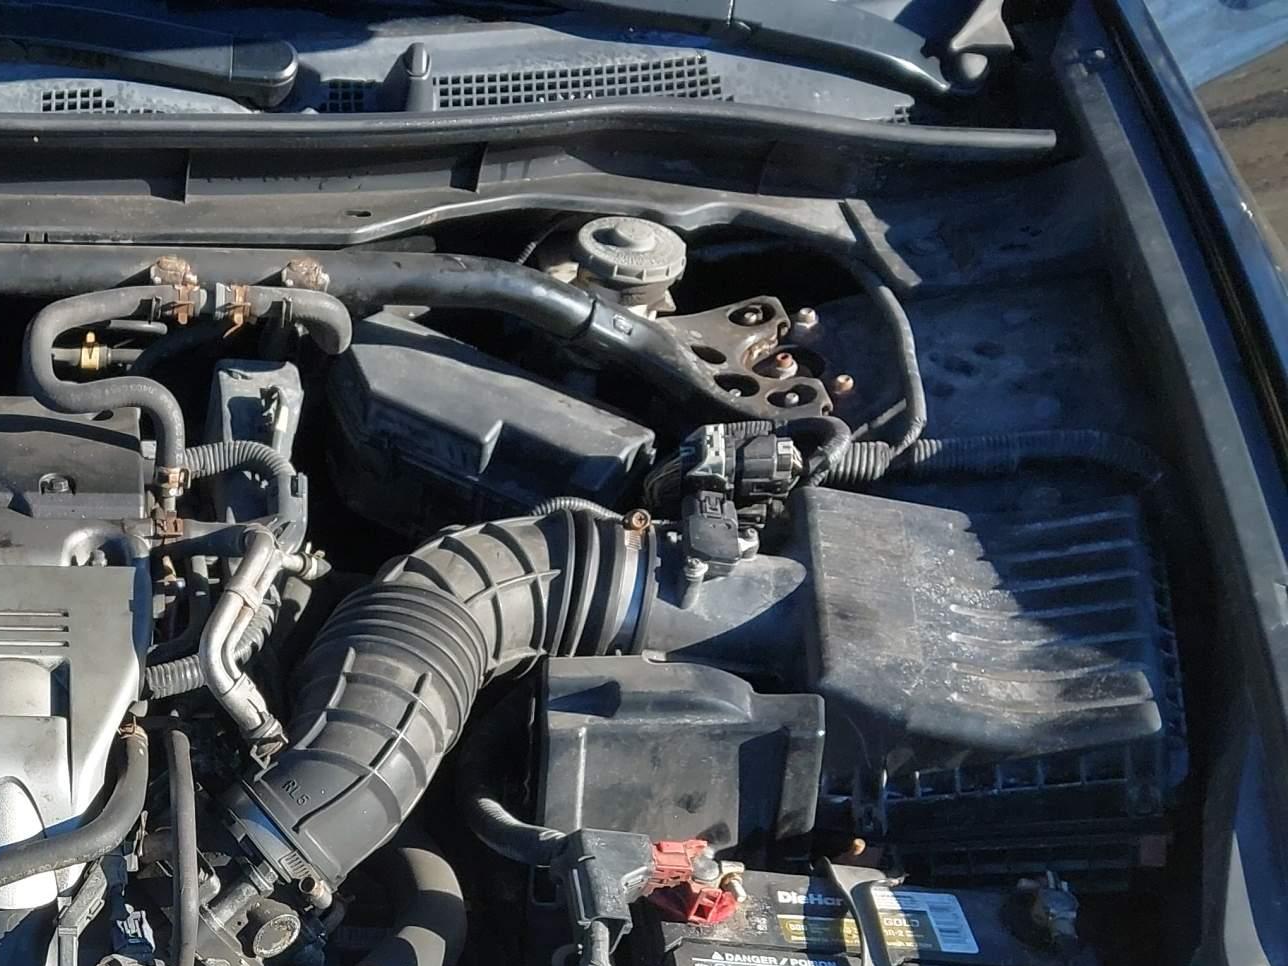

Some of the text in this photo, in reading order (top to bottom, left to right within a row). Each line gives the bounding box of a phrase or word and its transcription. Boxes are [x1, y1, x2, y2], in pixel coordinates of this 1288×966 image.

[777, 890, 843, 907] DieHar
[883, 917, 920, 928] GOLD
[724, 952, 778, 966] DANGER
